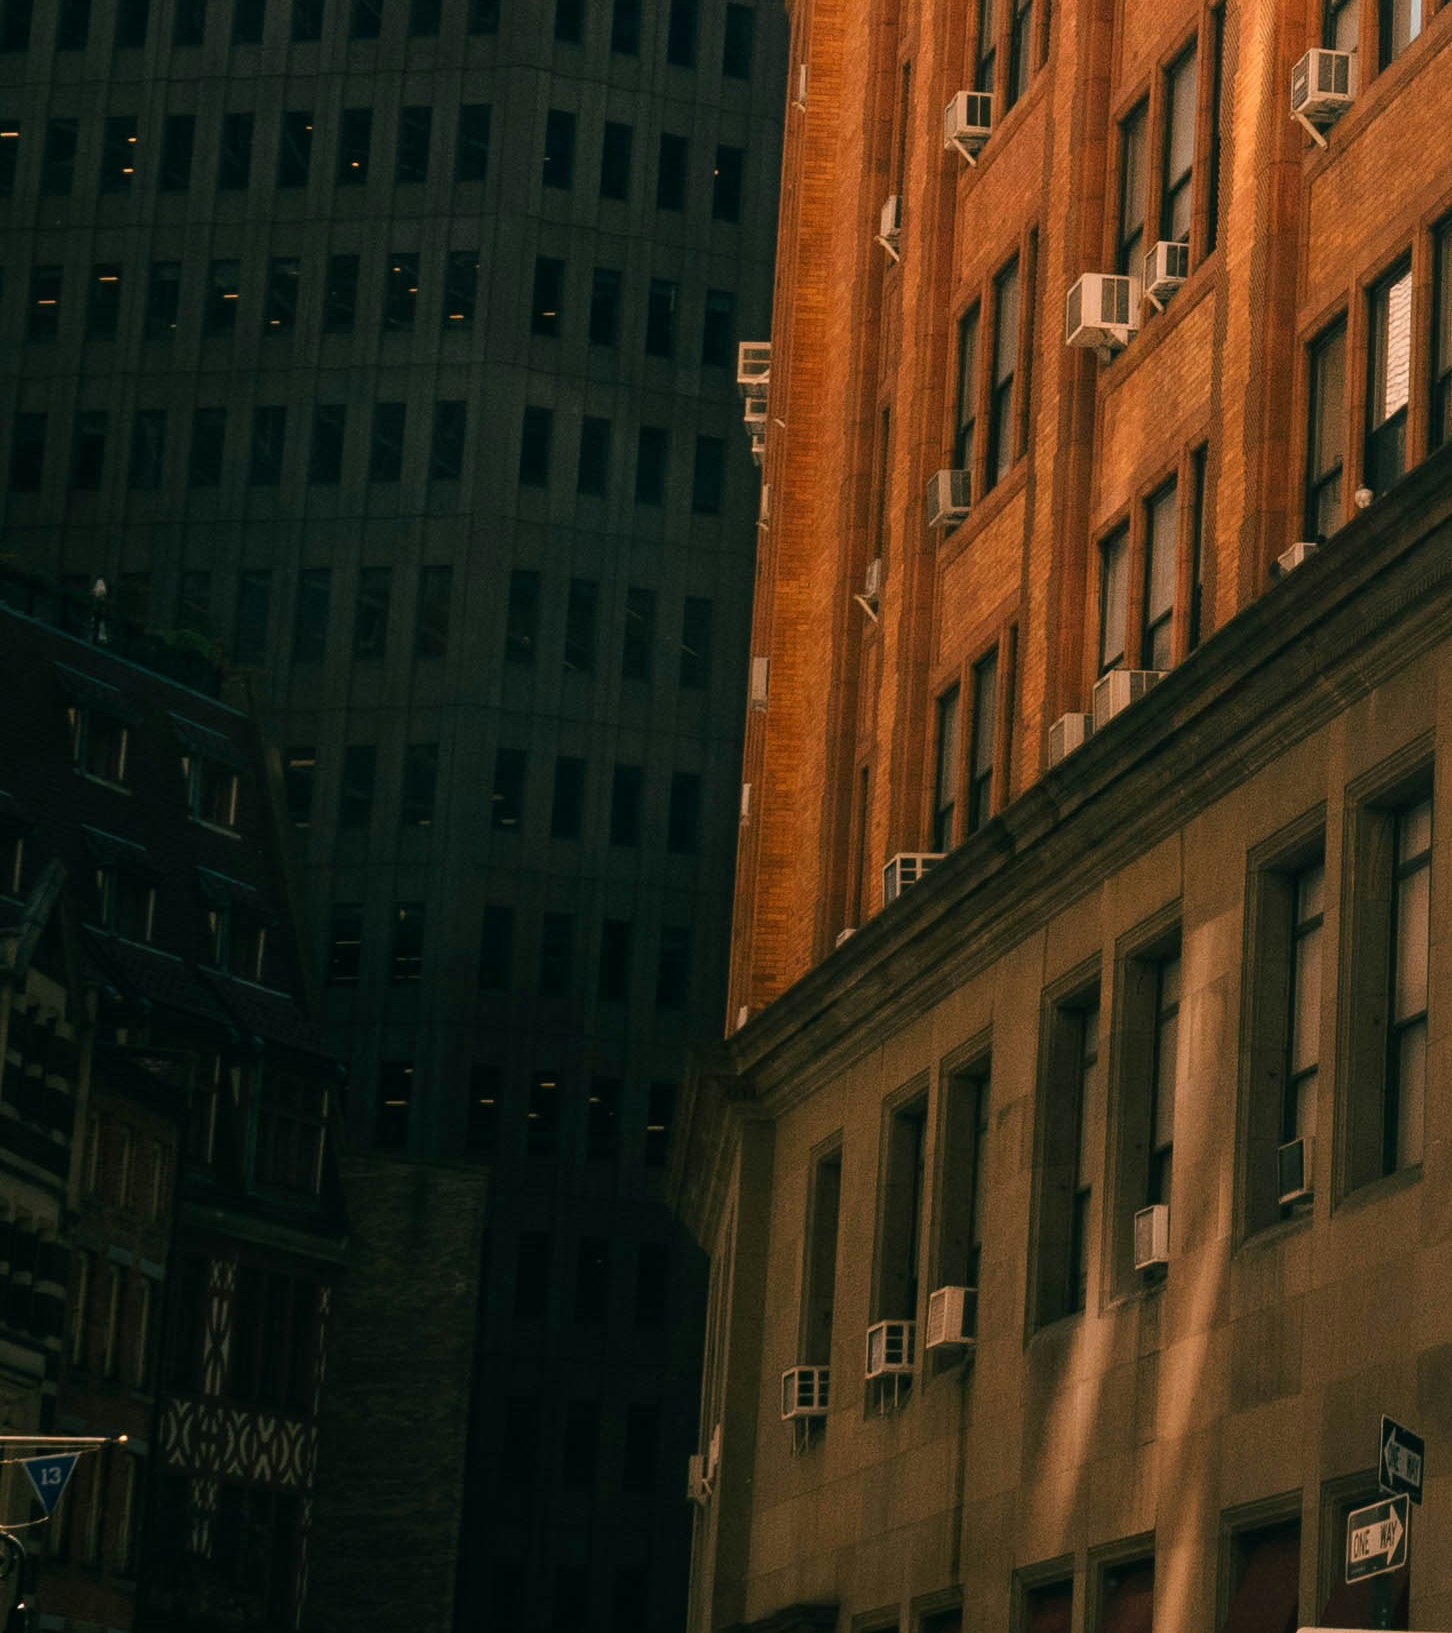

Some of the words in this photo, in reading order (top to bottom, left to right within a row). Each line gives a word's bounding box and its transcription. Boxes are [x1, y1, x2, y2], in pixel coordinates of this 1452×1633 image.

[41, 1467, 62, 1485] 13
[1354, 1528, 1370, 1559] ONE
[1380, 1520, 1397, 1549] WAY
